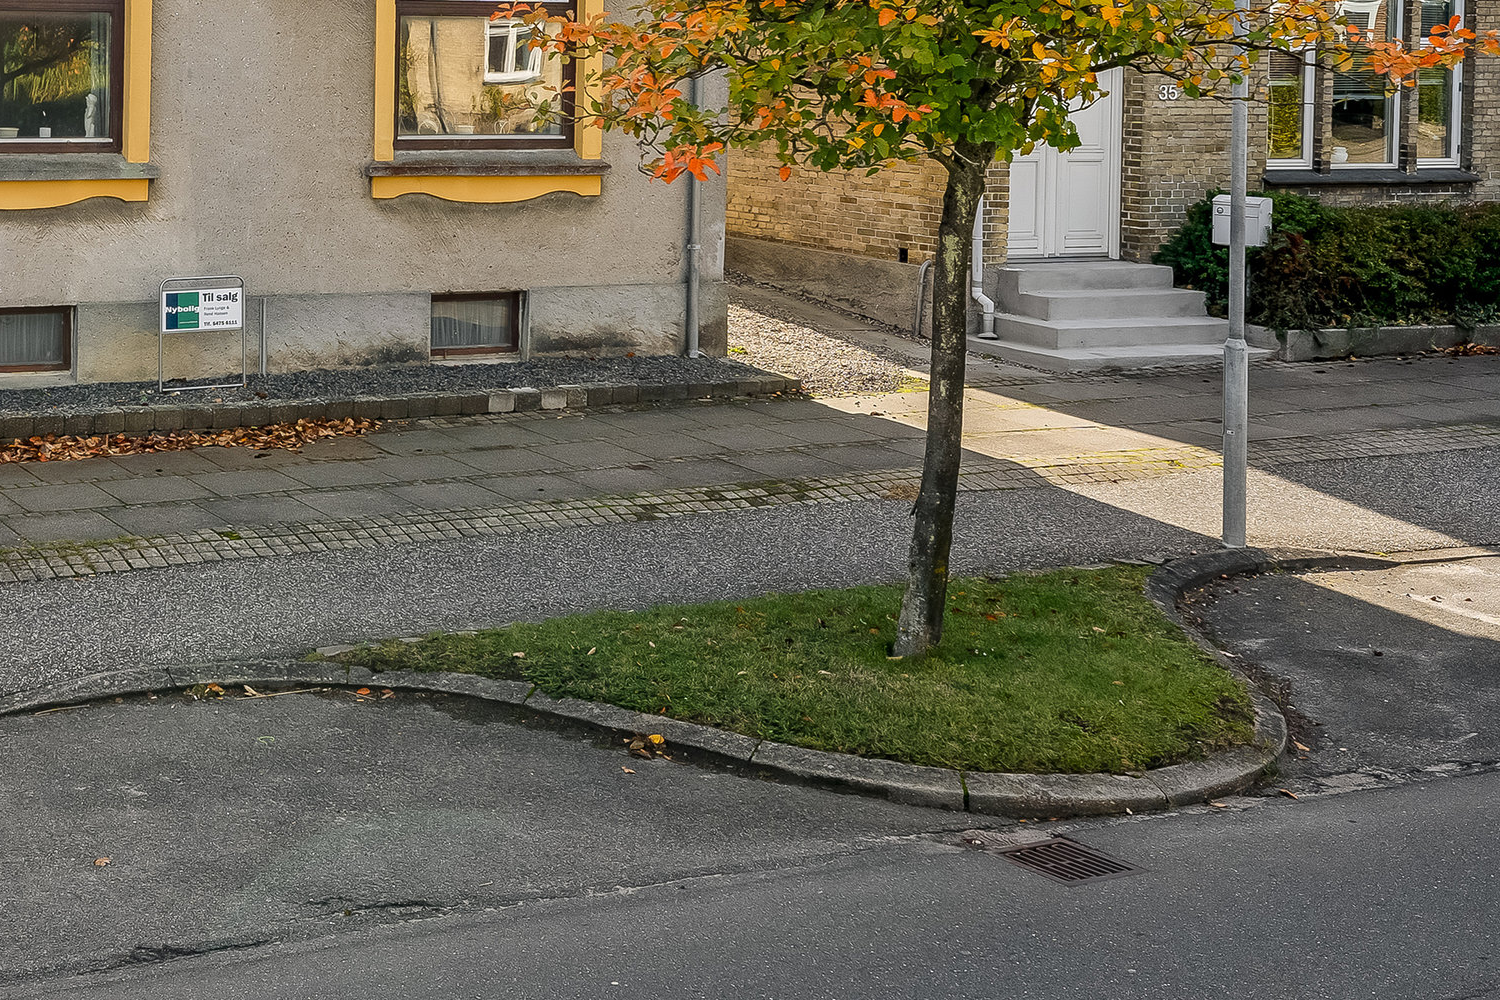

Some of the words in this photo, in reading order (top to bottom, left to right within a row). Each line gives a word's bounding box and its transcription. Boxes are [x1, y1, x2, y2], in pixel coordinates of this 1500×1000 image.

[1159, 85, 1178, 100] 35
[203, 293, 214, 302] Til
[216, 292, 238, 302] salg
[165, 306, 200, 314] Nybolig
